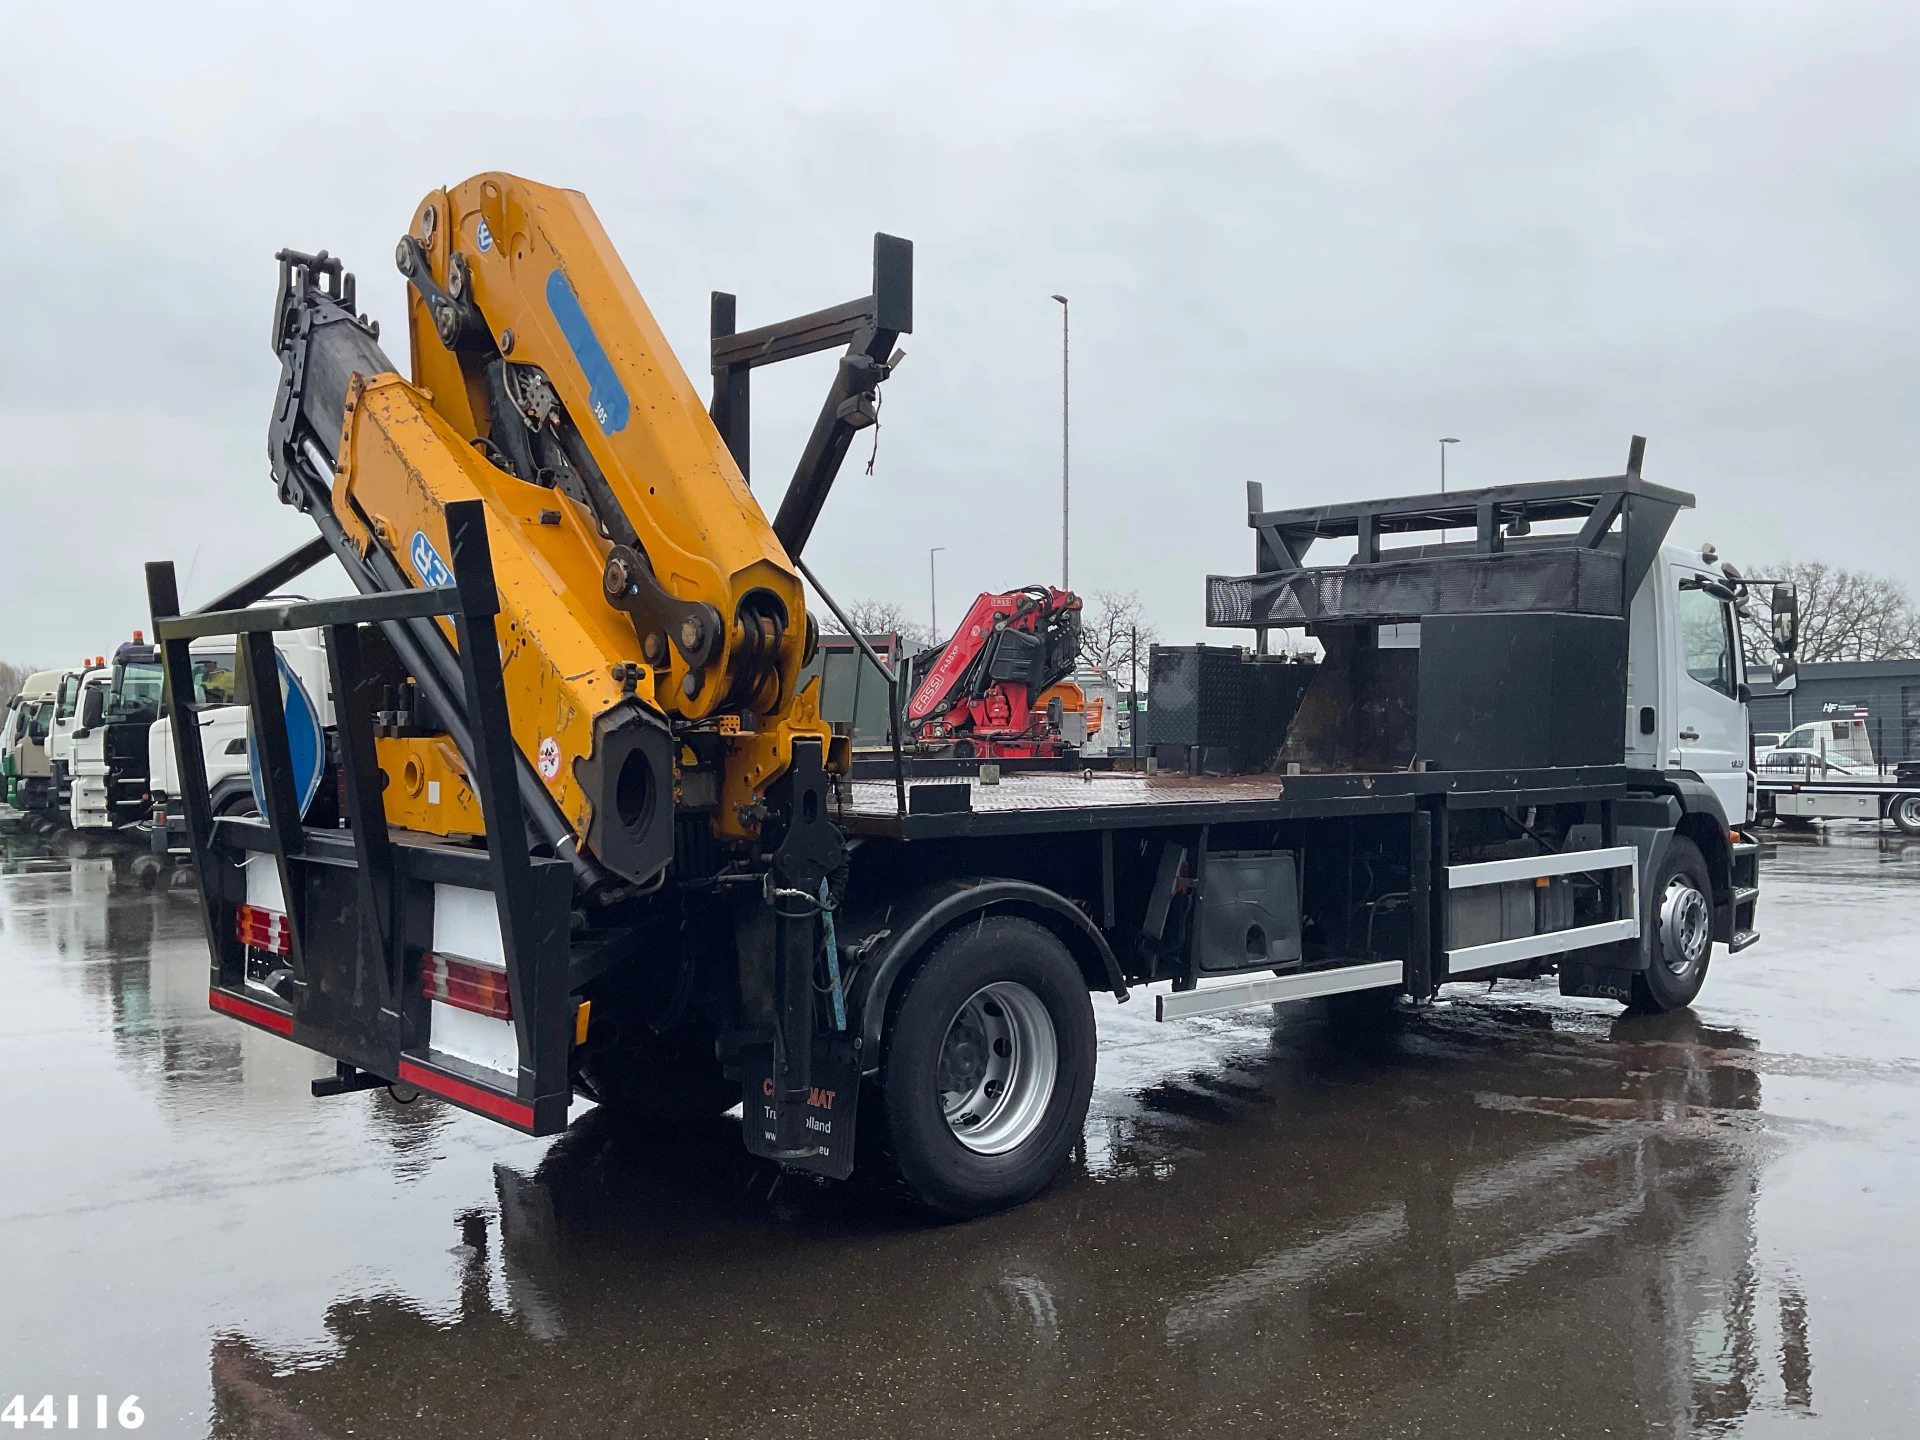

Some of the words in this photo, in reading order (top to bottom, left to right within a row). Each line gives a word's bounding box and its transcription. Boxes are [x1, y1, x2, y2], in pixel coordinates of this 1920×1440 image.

[594, 401, 608, 425] 305
[940, 645, 959, 673] F455XP
[914, 676, 943, 712] FASSI
[1822, 702, 1838, 714] HF
